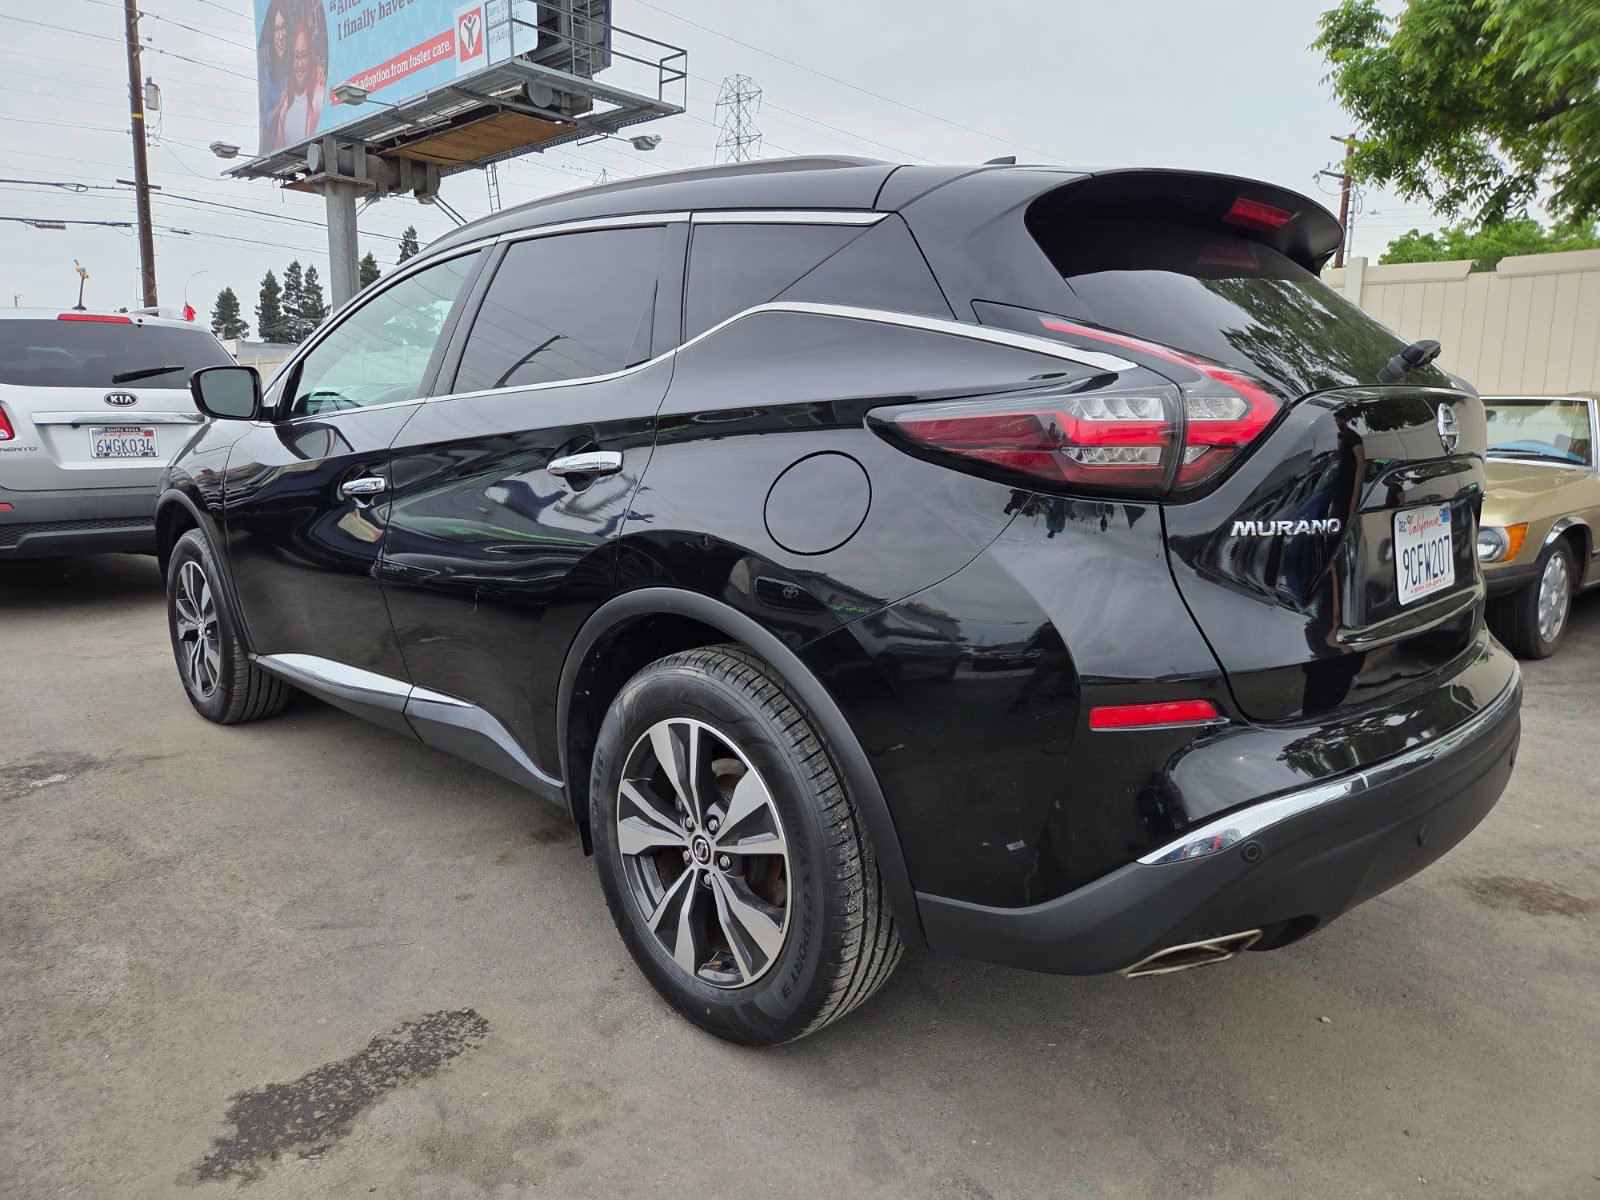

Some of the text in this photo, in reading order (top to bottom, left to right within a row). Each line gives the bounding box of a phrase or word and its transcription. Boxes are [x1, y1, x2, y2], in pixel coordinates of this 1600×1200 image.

[337, 23, 342, 41] I
[343, 8, 376, 38] finally
[378, 0, 405, 20] have
[360, 40, 452, 89] adoption from foster care.
[109, 394, 133, 404] KIA
[96, 438, 154, 453] 6WGK034
[1231, 519, 1341, 537] MURANO
[1408, 514, 1442, 539] California
[1402, 534, 1450, 591] 9CFW207
